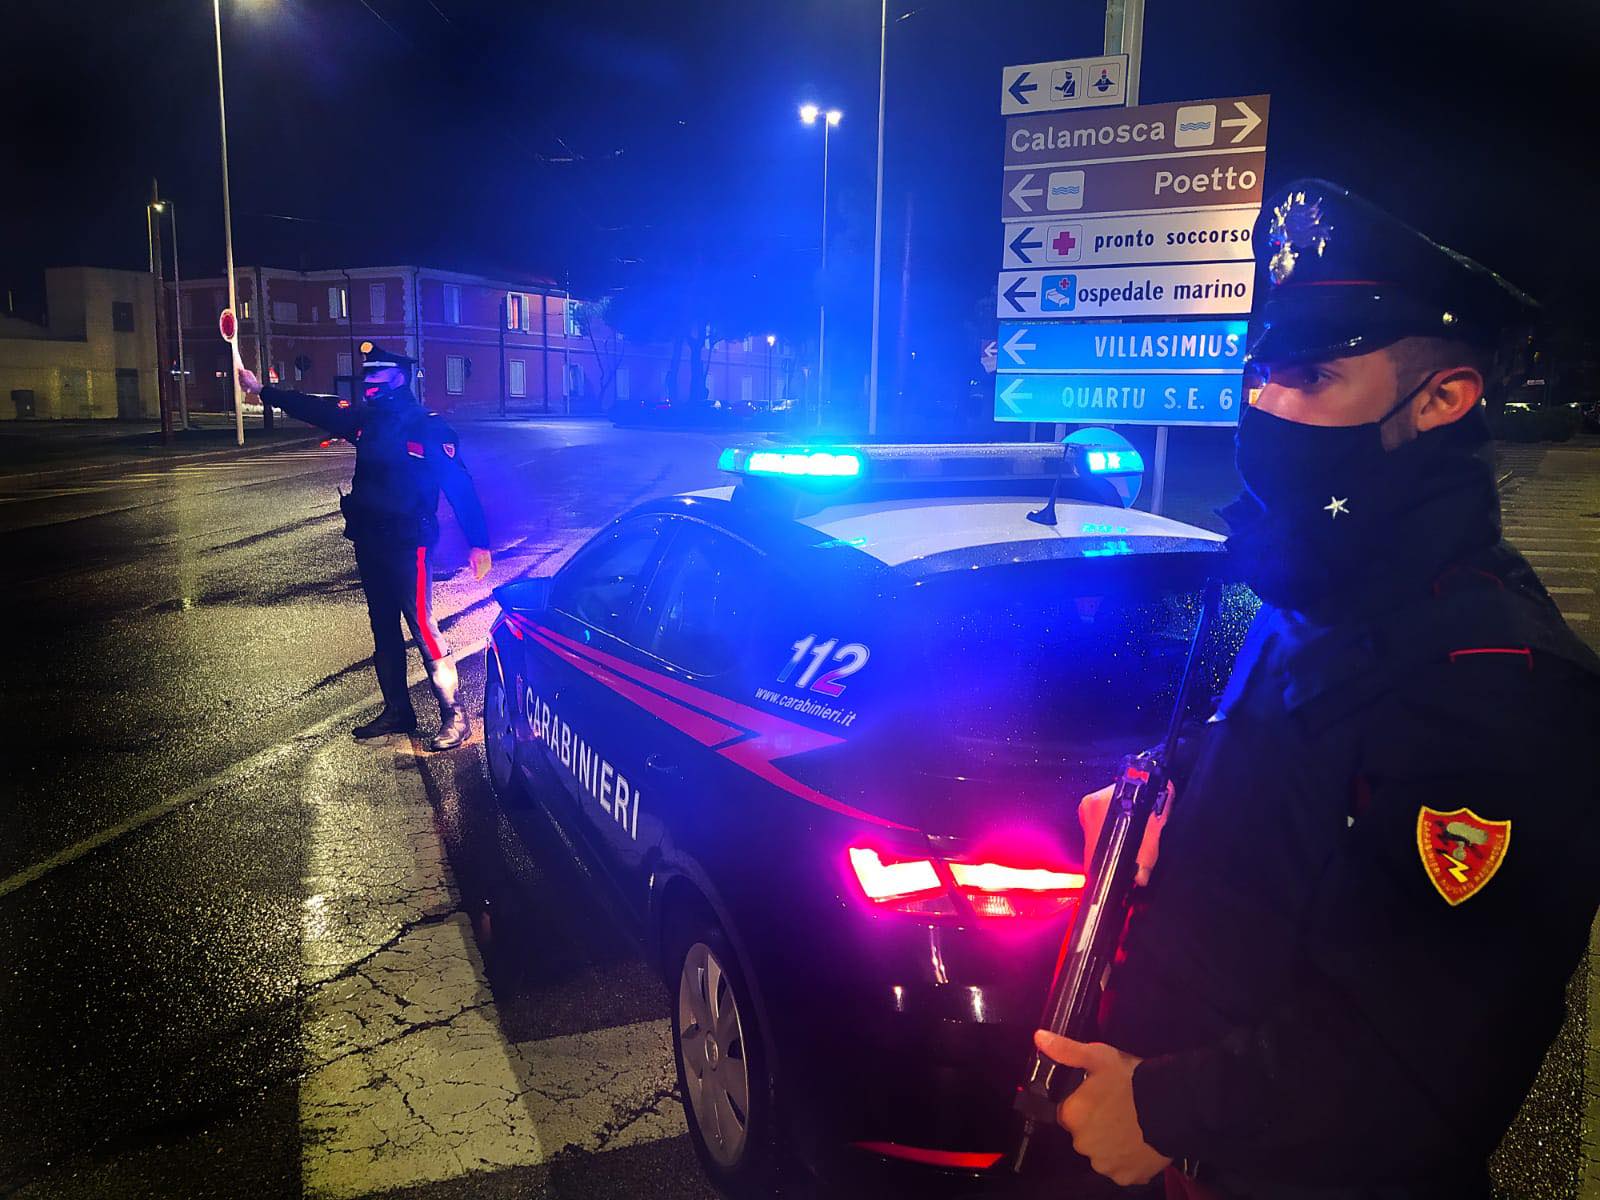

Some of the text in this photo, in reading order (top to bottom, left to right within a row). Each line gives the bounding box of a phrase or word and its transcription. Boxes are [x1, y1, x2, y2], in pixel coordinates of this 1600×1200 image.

[1011, 121, 1166, 153] Calamosca
[1154, 166, 1257, 195] Poetto
[1094, 228, 1251, 252] pronto soccorso
[1078, 279, 1246, 307] ospedale marino
[1094, 334, 1239, 358] VILLASIMIUS
[1062, 387, 1146, 409] QUARTU
[1219, 388, 1233, 410] 6
[776, 633, 871, 698] 112
[754, 687, 857, 727] www.carabinieri.it
[525, 685, 640, 841] CARABINIERI
